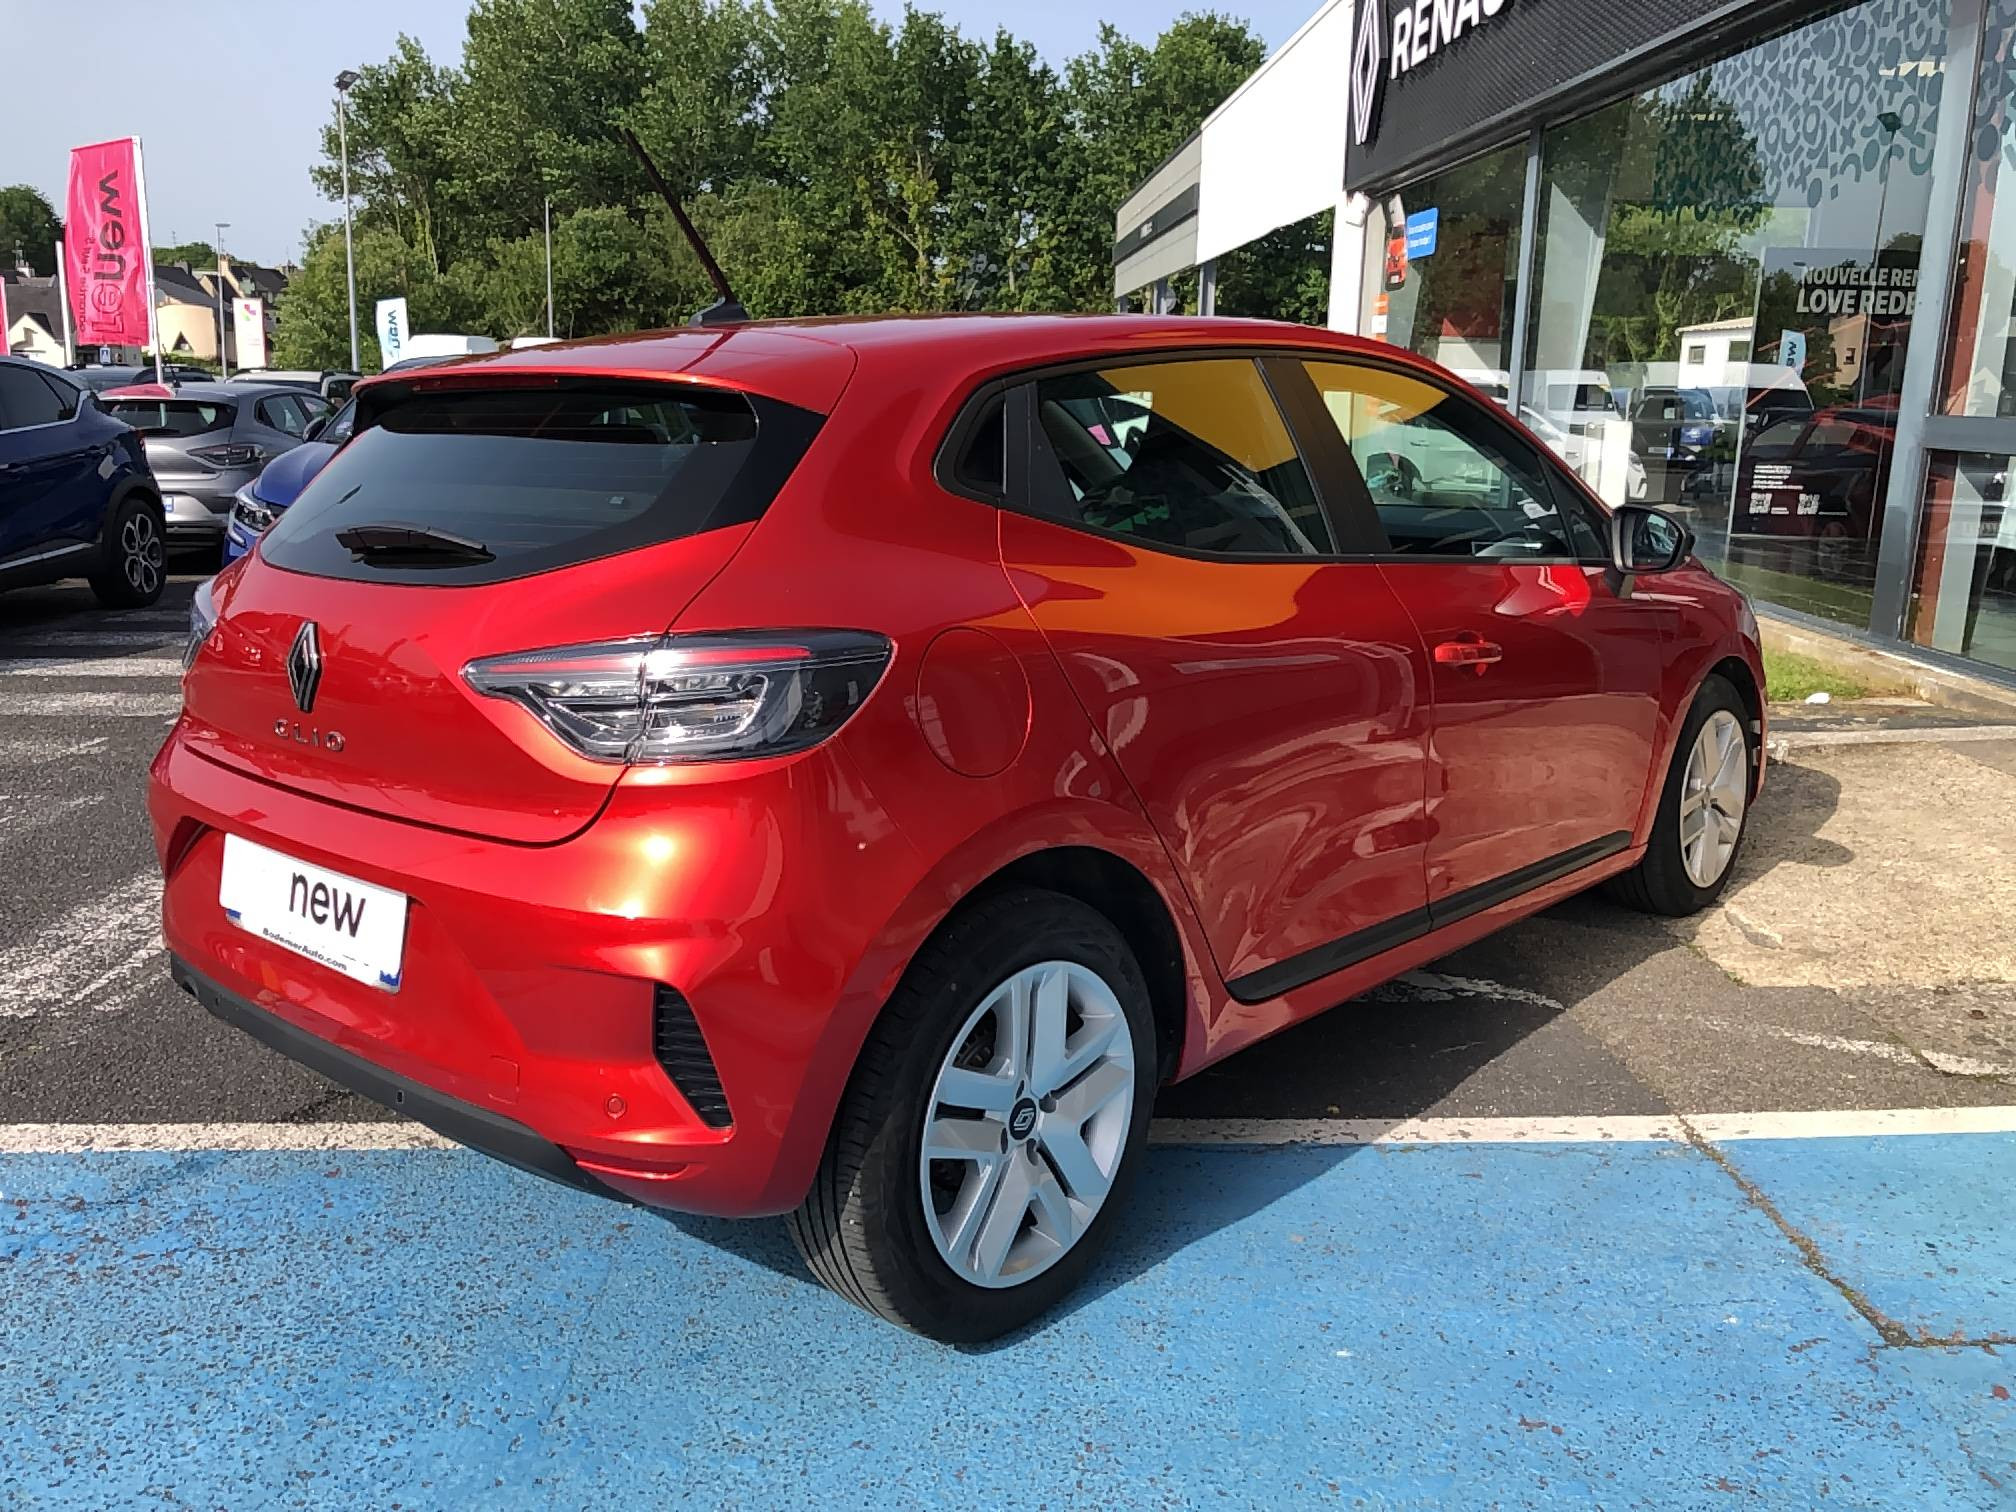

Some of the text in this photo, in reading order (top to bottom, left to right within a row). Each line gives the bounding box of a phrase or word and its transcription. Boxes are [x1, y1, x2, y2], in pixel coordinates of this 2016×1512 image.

[1802, 266, 1888, 286] NOUVELLE
[1796, 288, 1857, 314] LOVE
[274, 718, 346, 752] CLIO
[288, 871, 366, 938] new
[262, 927, 347, 971] BodemerAuto.com
